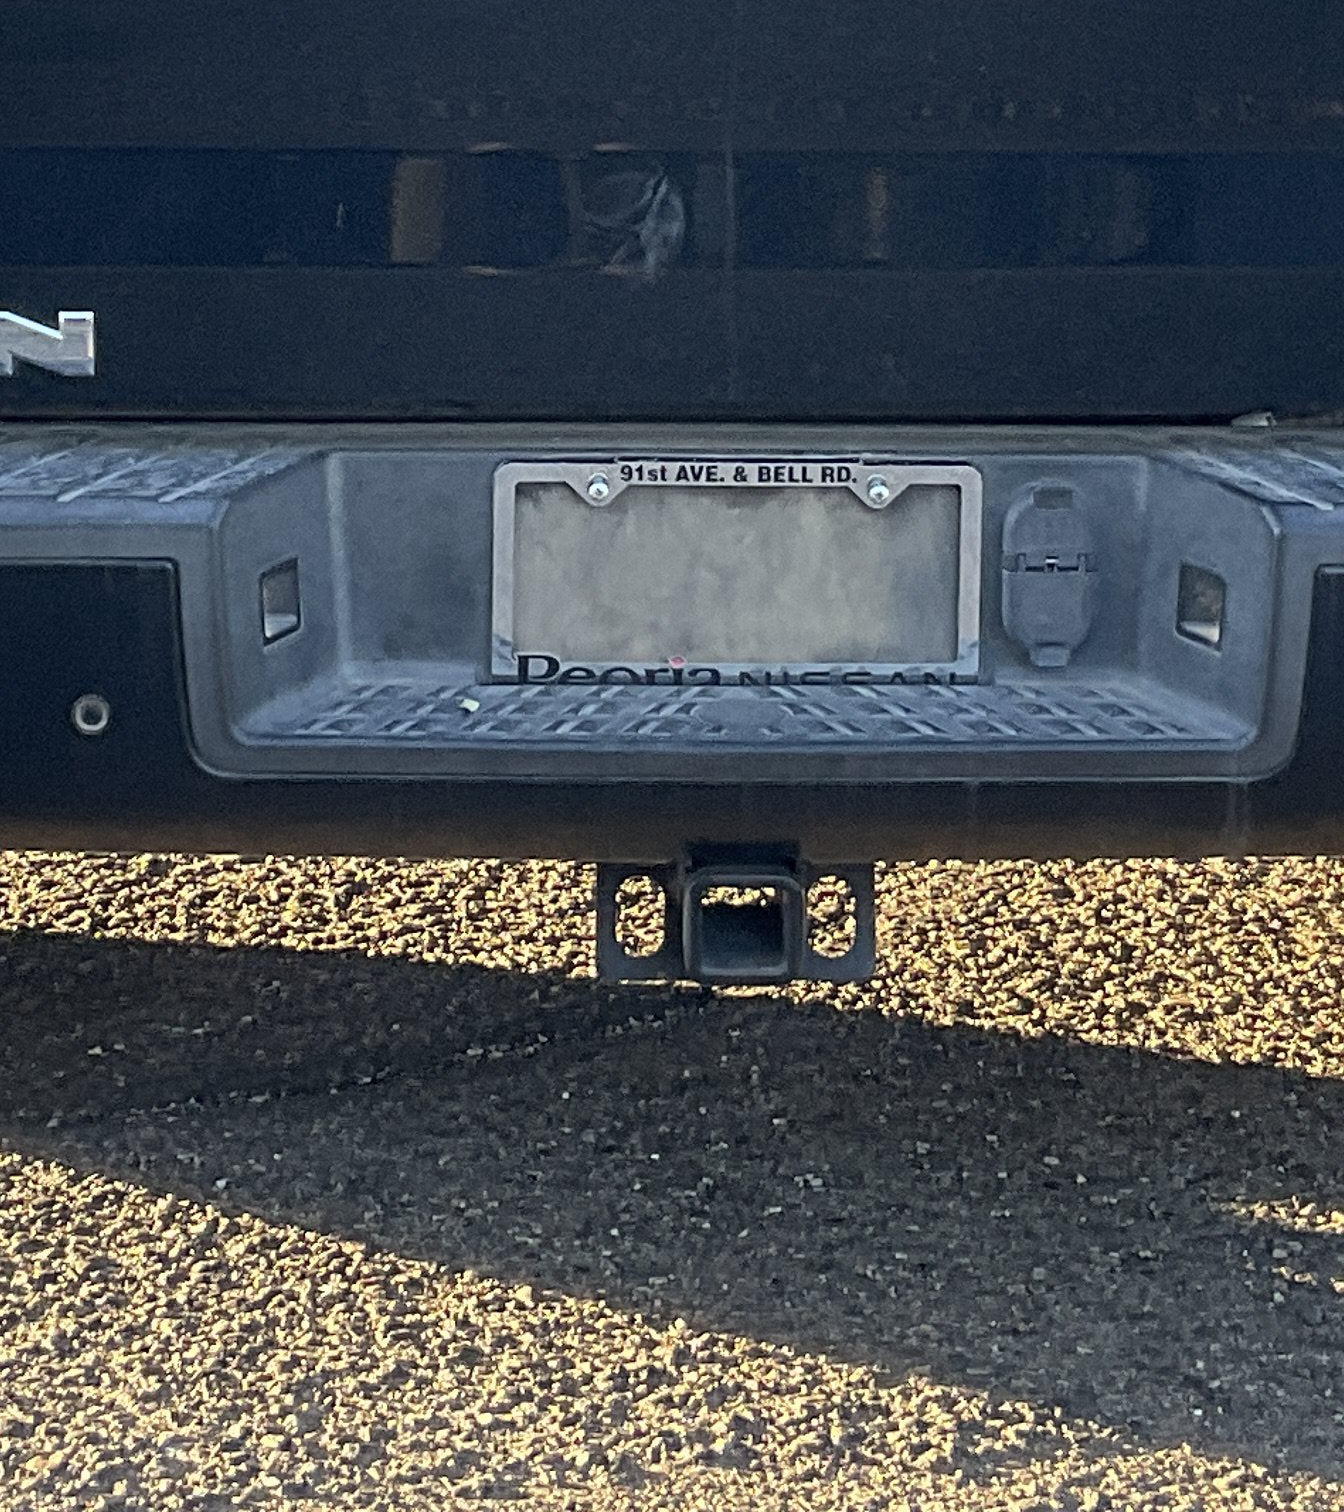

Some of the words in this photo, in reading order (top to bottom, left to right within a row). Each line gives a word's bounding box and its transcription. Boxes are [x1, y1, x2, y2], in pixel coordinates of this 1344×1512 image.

[620, 464, 667, 481] 91st
[675, 465, 725, 482] AVE.
[733, 466, 748, 482] &
[758, 465, 813, 483] BELL
[821, 466, 857, 483] RD.
[517, 654, 721, 686] Peoria
